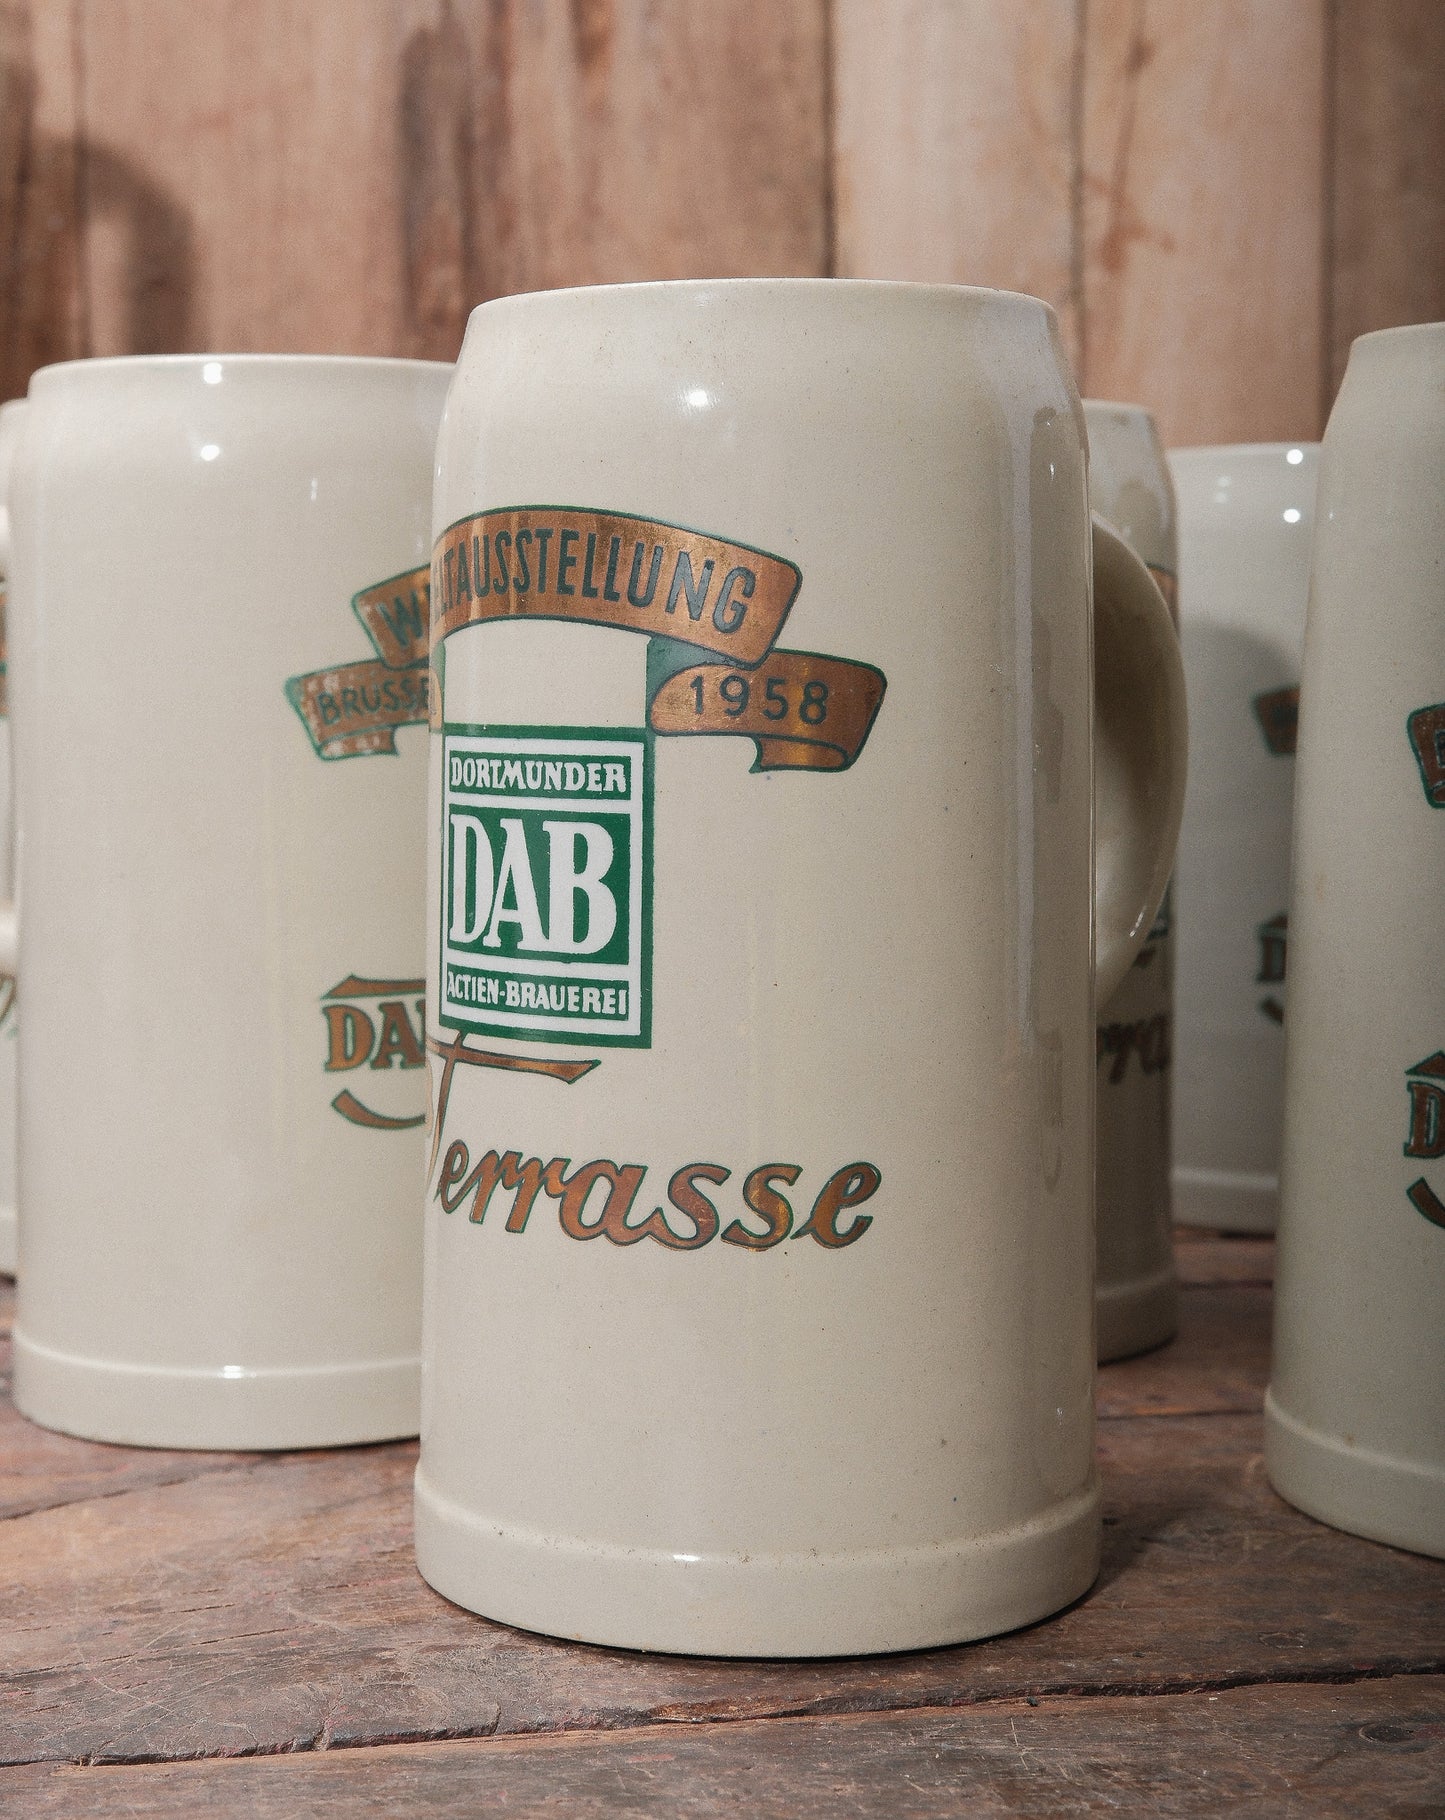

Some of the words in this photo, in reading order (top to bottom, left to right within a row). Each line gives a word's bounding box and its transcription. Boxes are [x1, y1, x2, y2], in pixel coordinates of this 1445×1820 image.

[689, 674, 831, 726] 1958
[450, 756, 627, 793] DORTMUNDER
[449, 813, 617, 955] DAB
[446, 970, 627, 1016] ACTIEN-BRAUEREI
[321, 999, 427, 1073] DA
